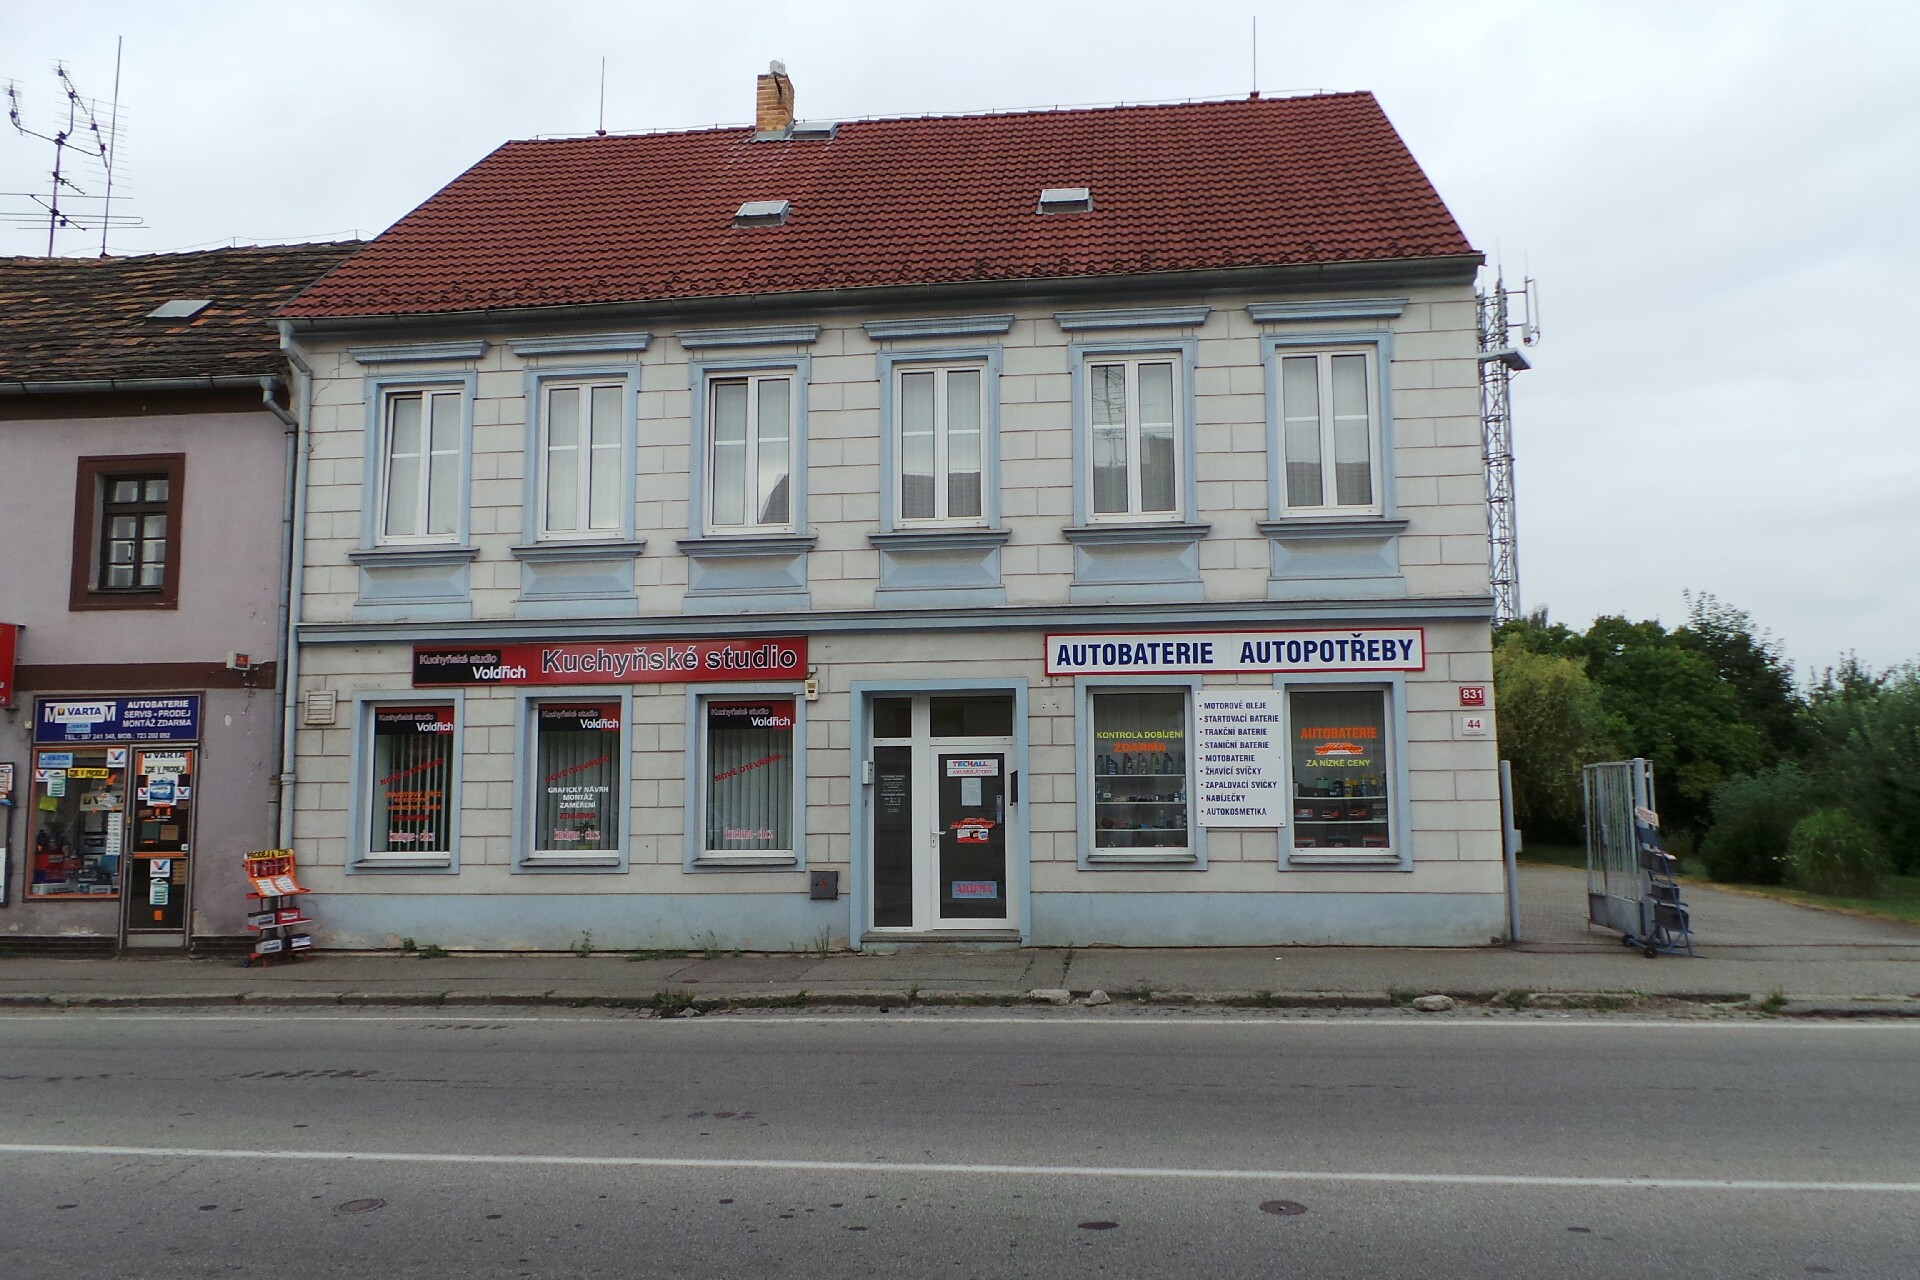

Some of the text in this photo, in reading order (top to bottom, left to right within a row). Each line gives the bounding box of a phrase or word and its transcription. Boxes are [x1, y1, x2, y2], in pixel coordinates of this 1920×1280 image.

[1056, 633, 1413, 666] AUTOBATERIE AUTOPOTŘEBY
[419, 653, 498, 666] Kuchyňské studio
[541, 644, 798, 678] Kuchyňské studio
[472, 664, 527, 680] Voldřich
[1463, 689, 1483, 699] 831
[127, 700, 189, 709] AUTOBATERIE
[1204, 700, 1243, 709] MOTOROVÉ
[67, 707, 102, 716] VARTA
[124, 709, 191, 719] SERVIS PRODEJ
[578, 709, 598, 718] studio
[748, 707, 770, 715] studio
[750, 716, 790, 727] Voldřich
[1204, 713, 1279, 723] STARTOVACÍ BATERIE
[122, 718, 191, 728] MONTÁŽ ZDARMA
[416, 722, 454, 731] Voldřich
[580, 718, 619, 729] Voldřich
[1467, 719, 1481, 728] 44
[1096, 730, 1184, 739] KONTROLA DOBÍJENÍ
[1205, 727, 1235, 735] TRAKČNÍ
[1301, 727, 1377, 739] AUTOBATERIE
[1112, 742, 1168, 753] ZDARMA
[1205, 740, 1269, 749] STANIČNÍ BATERIE
[1306, 758, 1371, 767] ZA NÍZKÉ CENY
[1205, 766, 1262, 775] ŽHAVÍCÍ SVÍČKY
[1205, 779, 1277, 789] ZAPALOVACÍ SVÍČKY
[547, 785, 609, 794] GRAFICKÝ NÁVRH
[562, 793, 594, 801] MONTÁŽ
[1206, 793, 1245, 802] NABÍJEČKY
[559, 812, 596, 820] ZDARMA
[1206, 808, 1267, 816] AUTOKOSMETIKA
